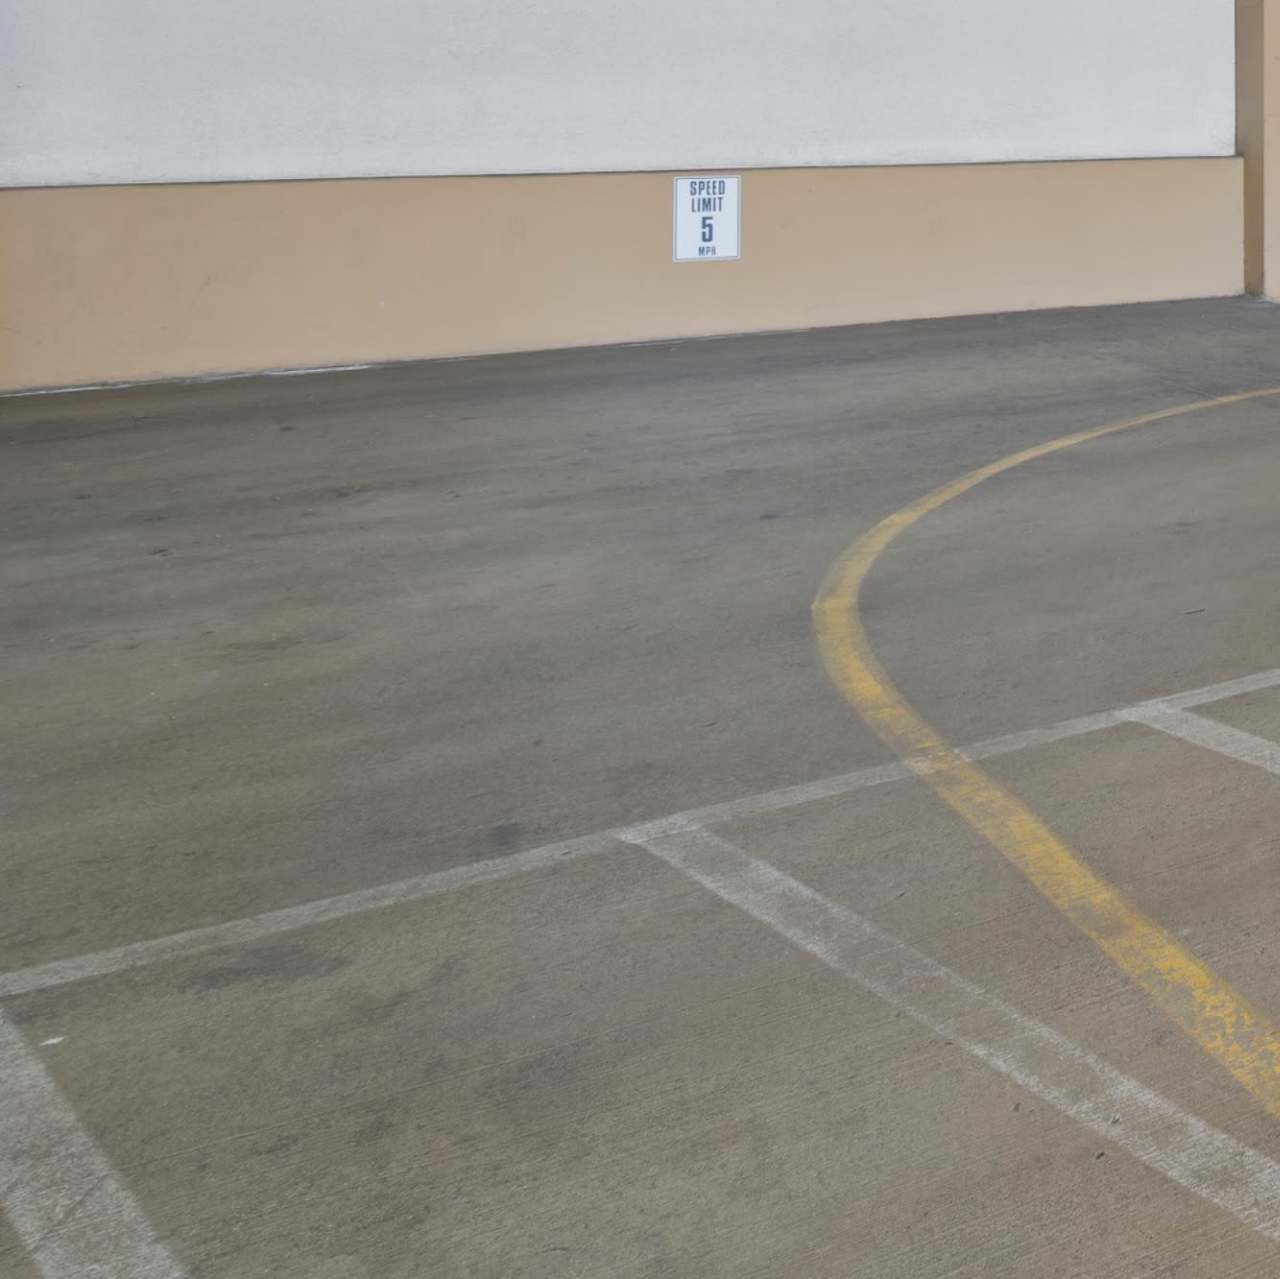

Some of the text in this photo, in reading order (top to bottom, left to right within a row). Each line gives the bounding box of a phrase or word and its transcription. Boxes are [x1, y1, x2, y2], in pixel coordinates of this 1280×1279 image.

[690, 180, 725, 196] SPEED
[691, 197, 723, 213] LIMIT
[701, 216, 713, 242] 5
[698, 246, 716, 256] MPH
